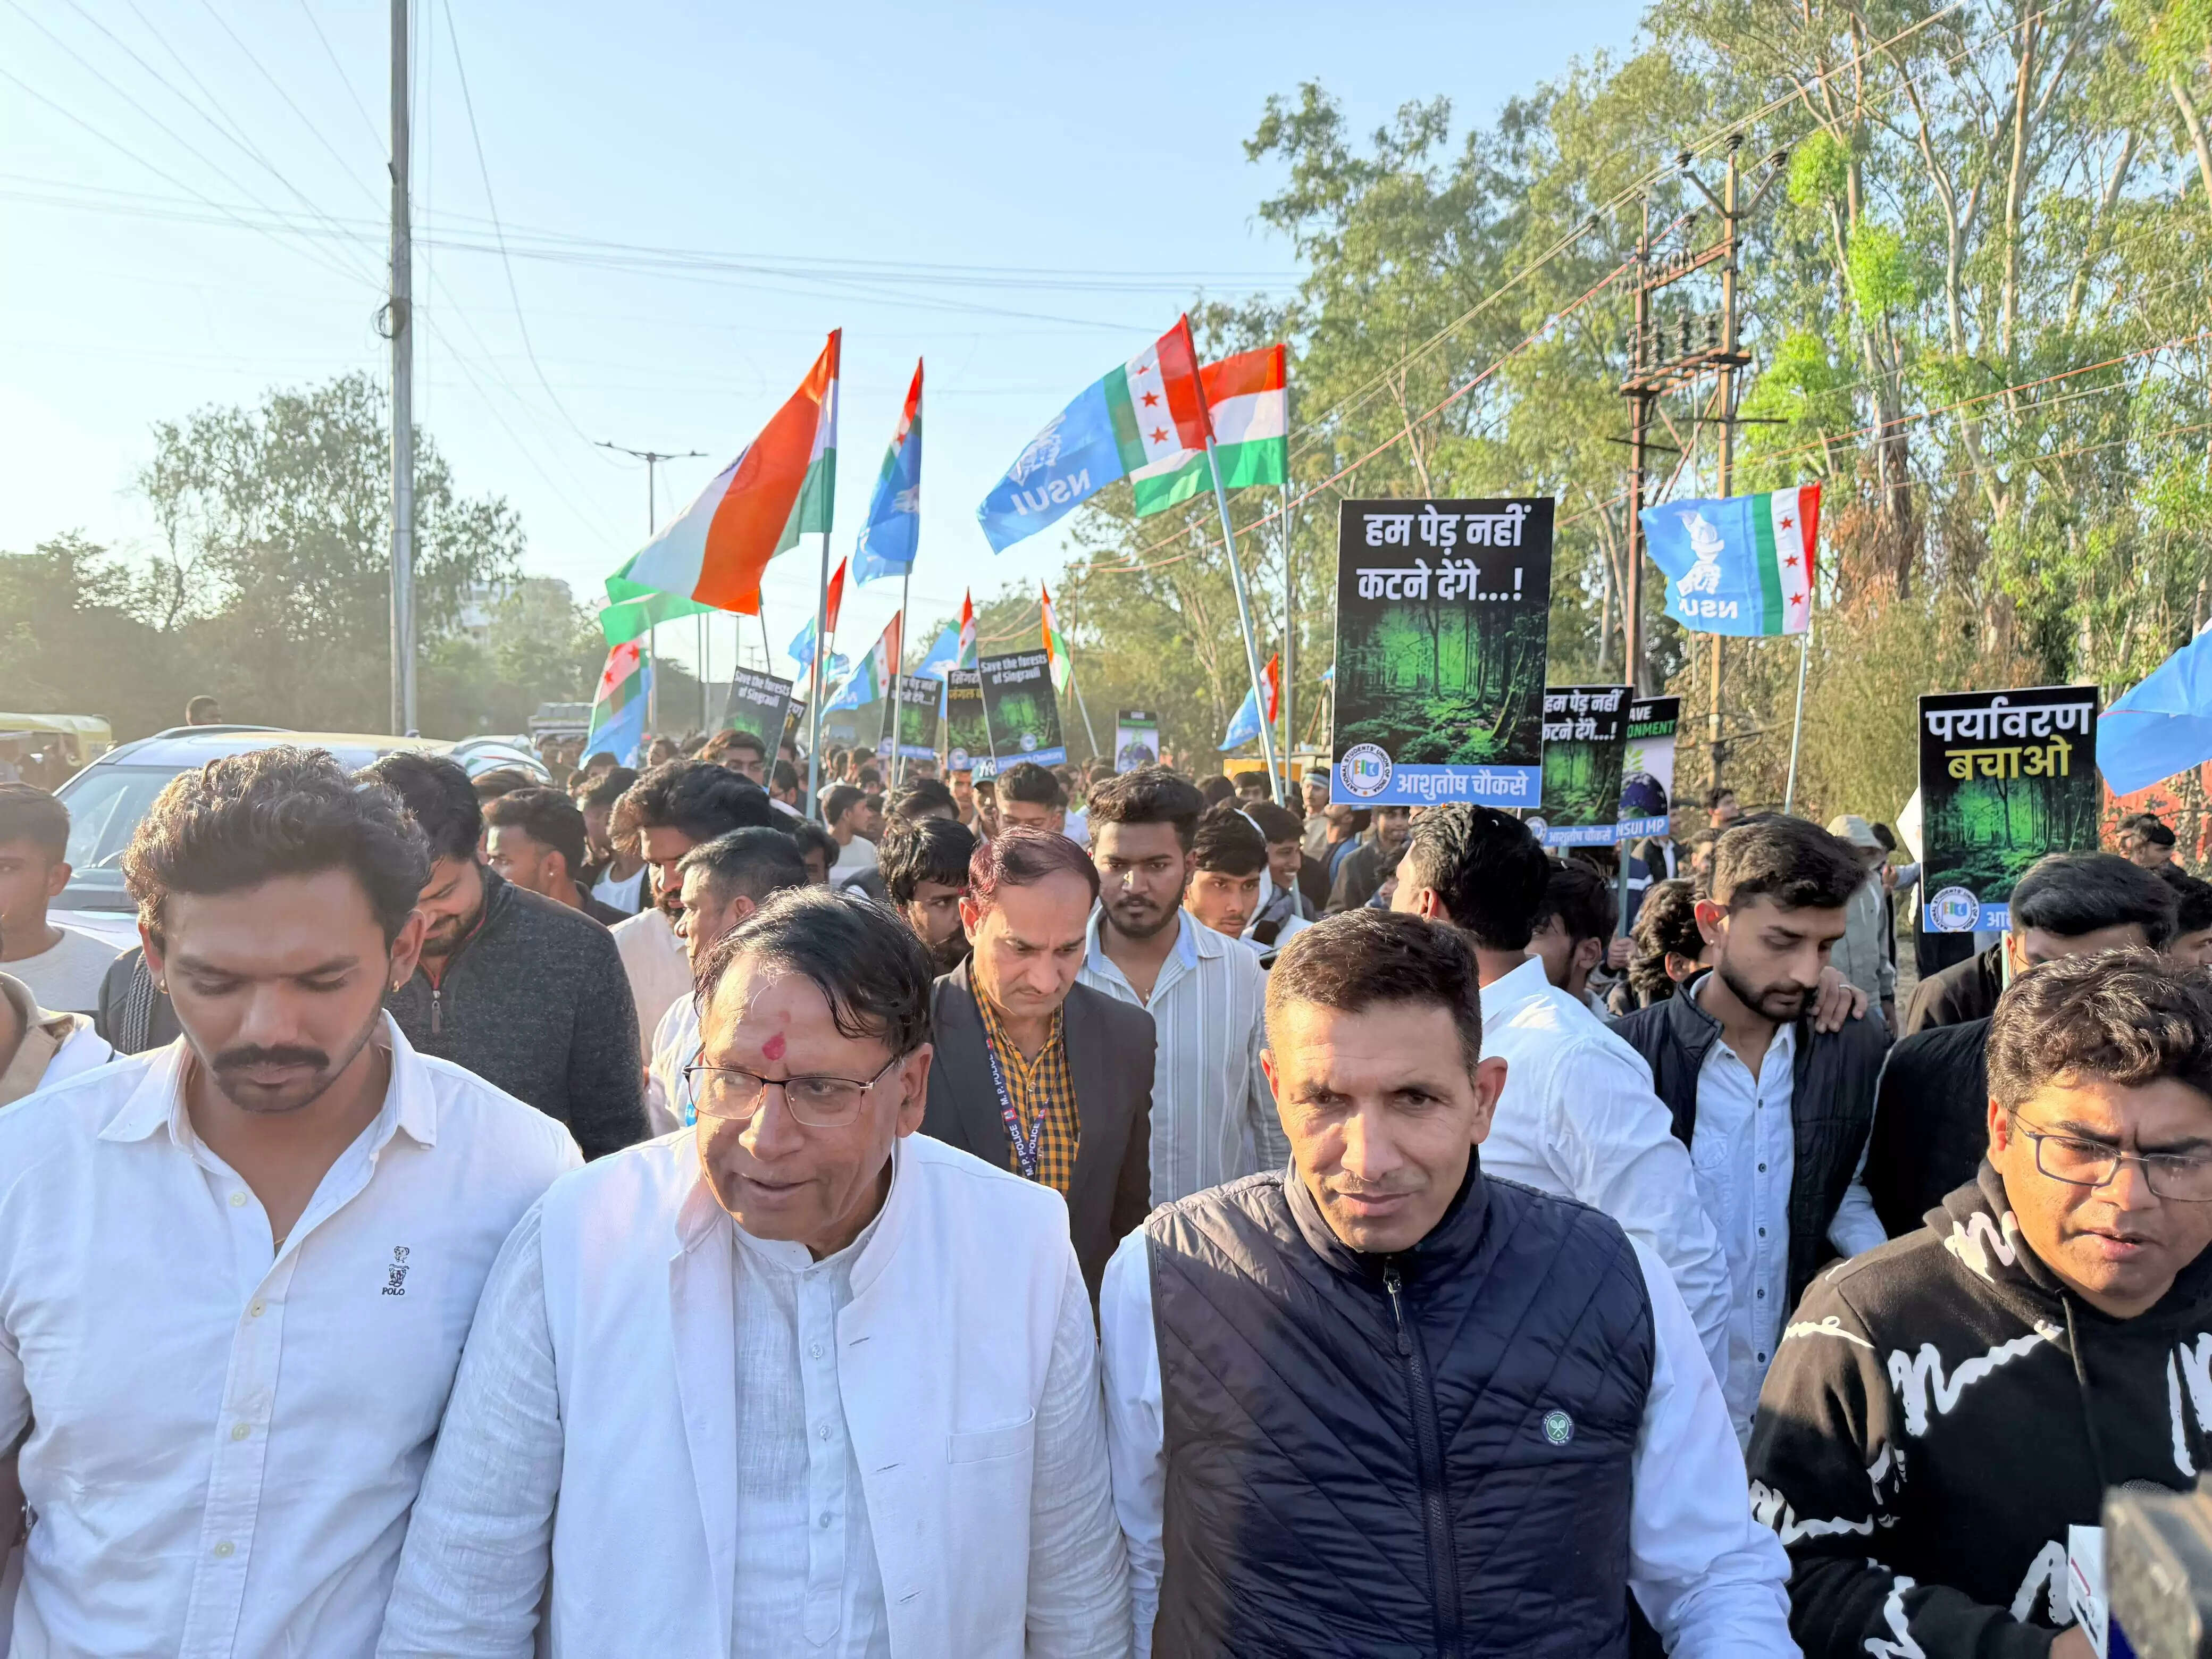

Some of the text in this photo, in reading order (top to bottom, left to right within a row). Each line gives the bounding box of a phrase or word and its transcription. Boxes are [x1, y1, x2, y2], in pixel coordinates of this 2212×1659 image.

[1363, 503, 1532, 556] हम पेड़ नहीं
[1356, 558, 1432, 601] कटने
[1002, 657, 1018, 669] the
[1544, 688, 1626, 717] हम पेड़ नहीं
[1629, 706, 1652, 722] AVE
[1626, 719, 1676, 739] ONMENT
[1925, 696, 2093, 742] पर्यावरण
[1376, 749, 1390, 767] UNION
[1945, 734, 2072, 781] बचाओ
[1342, 765, 1358, 795] NATIONAL
[1372, 779, 1387, 792] INDIA
[1397, 769, 1529, 800] आशुतोष चौकसे
[1616, 819, 1665, 836] NSUI MP
[1010, 1124, 1027, 1157] POLICE
[1029, 1122, 1041, 1155] POLICE
[1021, 1157, 1030, 1166] P.
[382, 1287, 405, 1296] POLO
